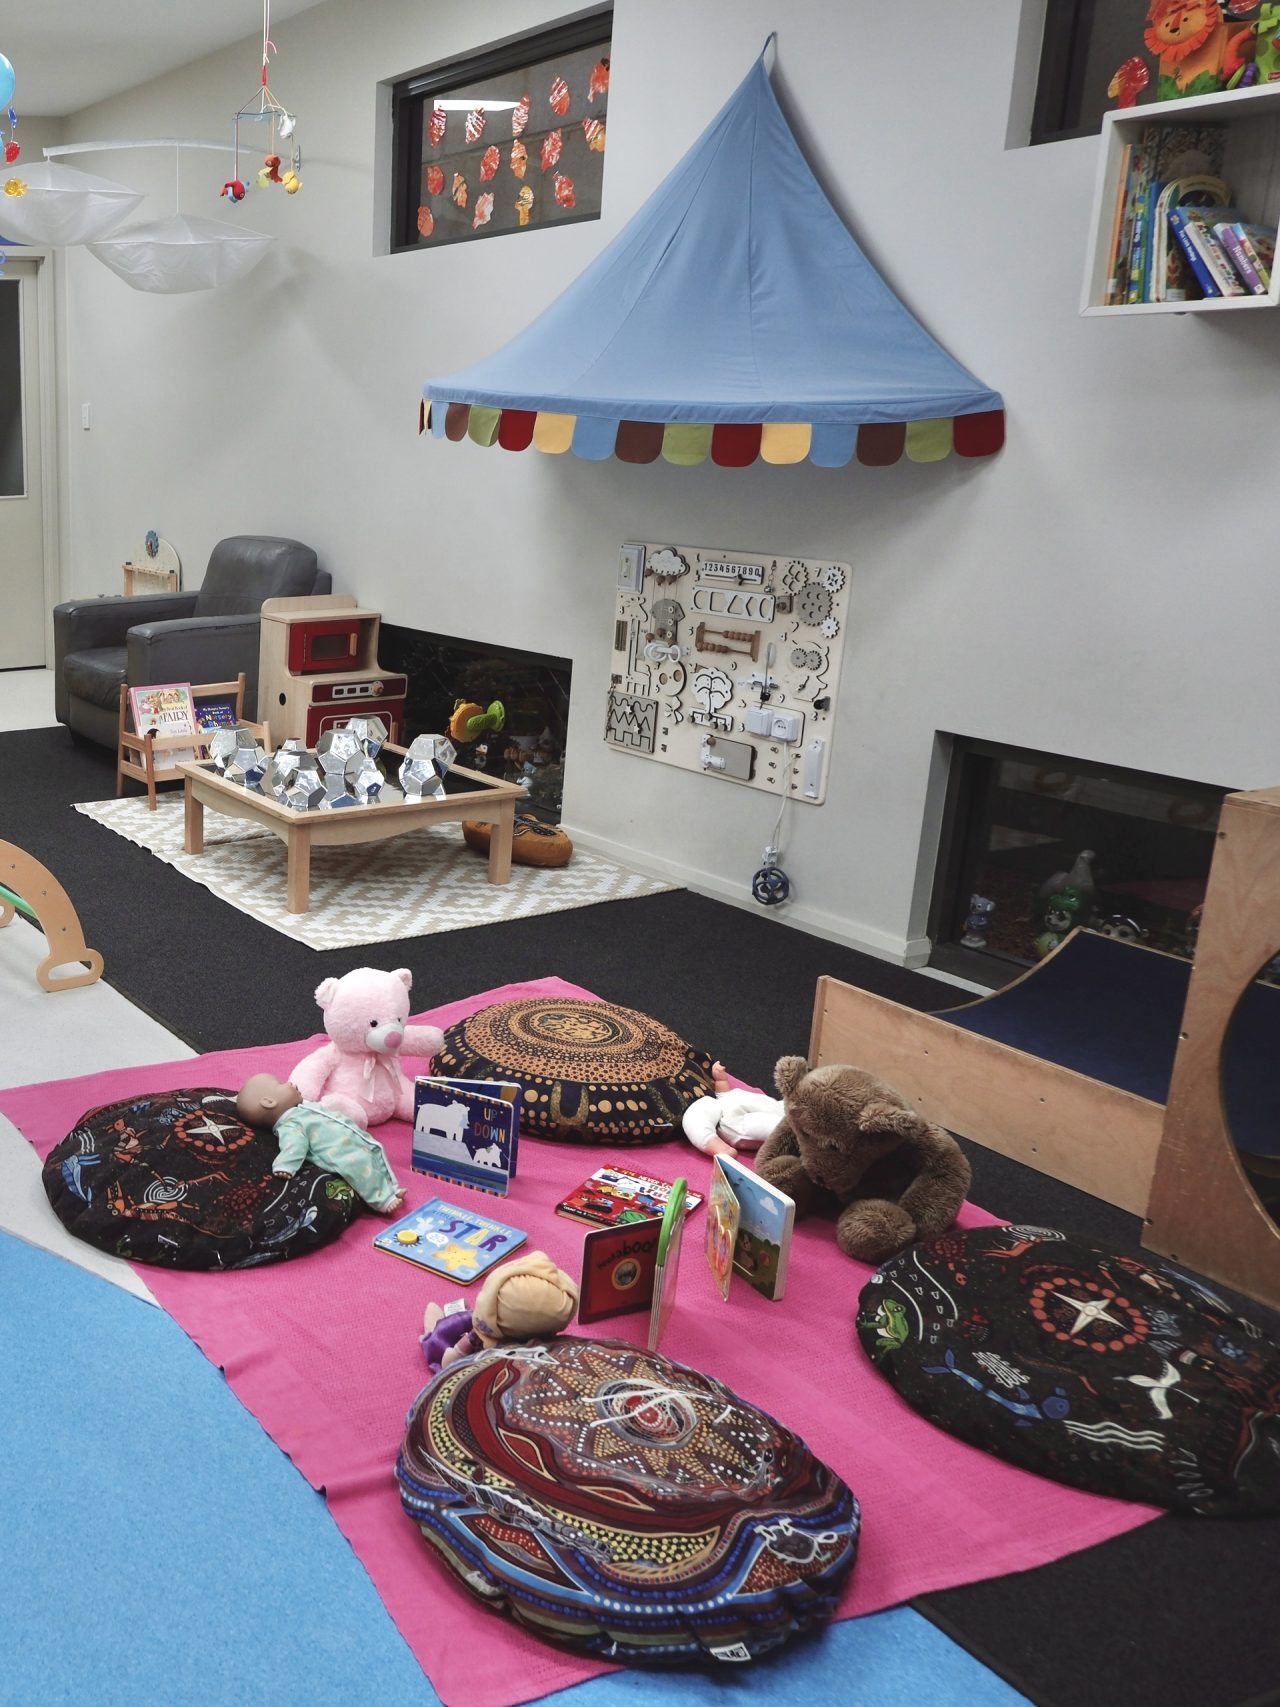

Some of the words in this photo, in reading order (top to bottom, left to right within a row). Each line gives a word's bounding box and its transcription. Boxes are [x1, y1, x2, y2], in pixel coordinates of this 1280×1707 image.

[1232, 245, 1252, 274] Numbers
[484, 1107, 498, 1121] UP
[475, 1122, 505, 1143] DOWN
[439, 1219, 508, 1252] STAR
